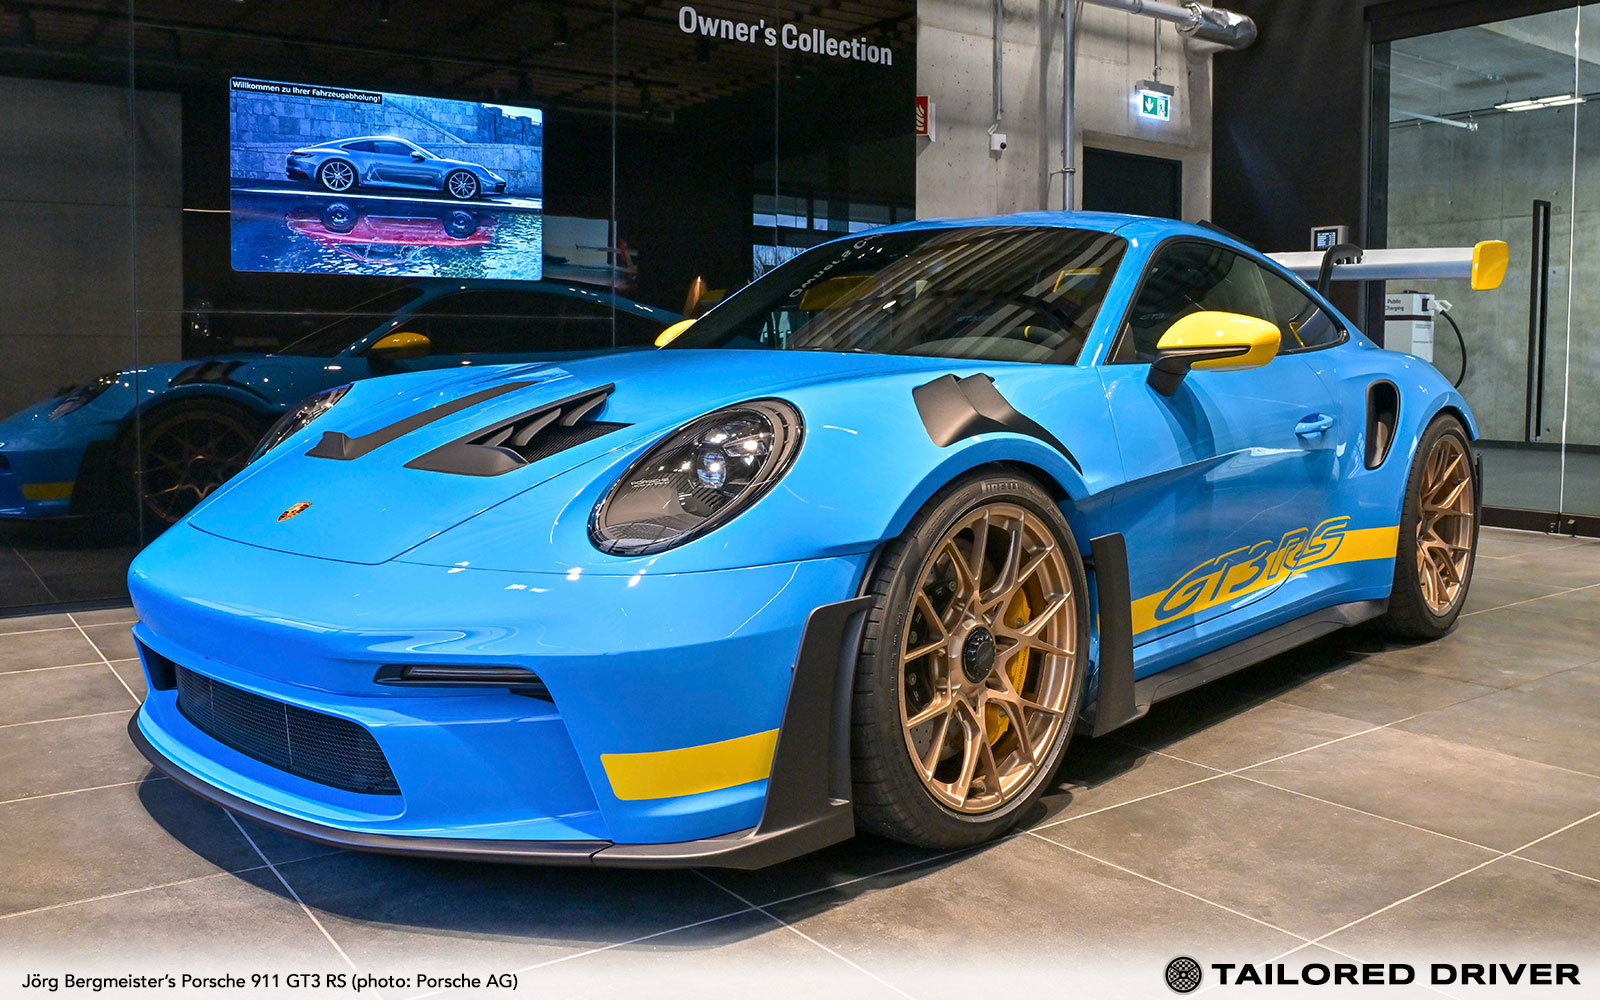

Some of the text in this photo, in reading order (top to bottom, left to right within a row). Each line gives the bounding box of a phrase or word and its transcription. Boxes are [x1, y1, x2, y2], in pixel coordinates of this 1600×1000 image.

[678, 6, 893, 66] Owner's Collection
[232, 80, 280, 92] Willkommen
[292, 87, 311, 95] Ihrer
[312, 88, 381, 103] Fahrzeugabholung!
